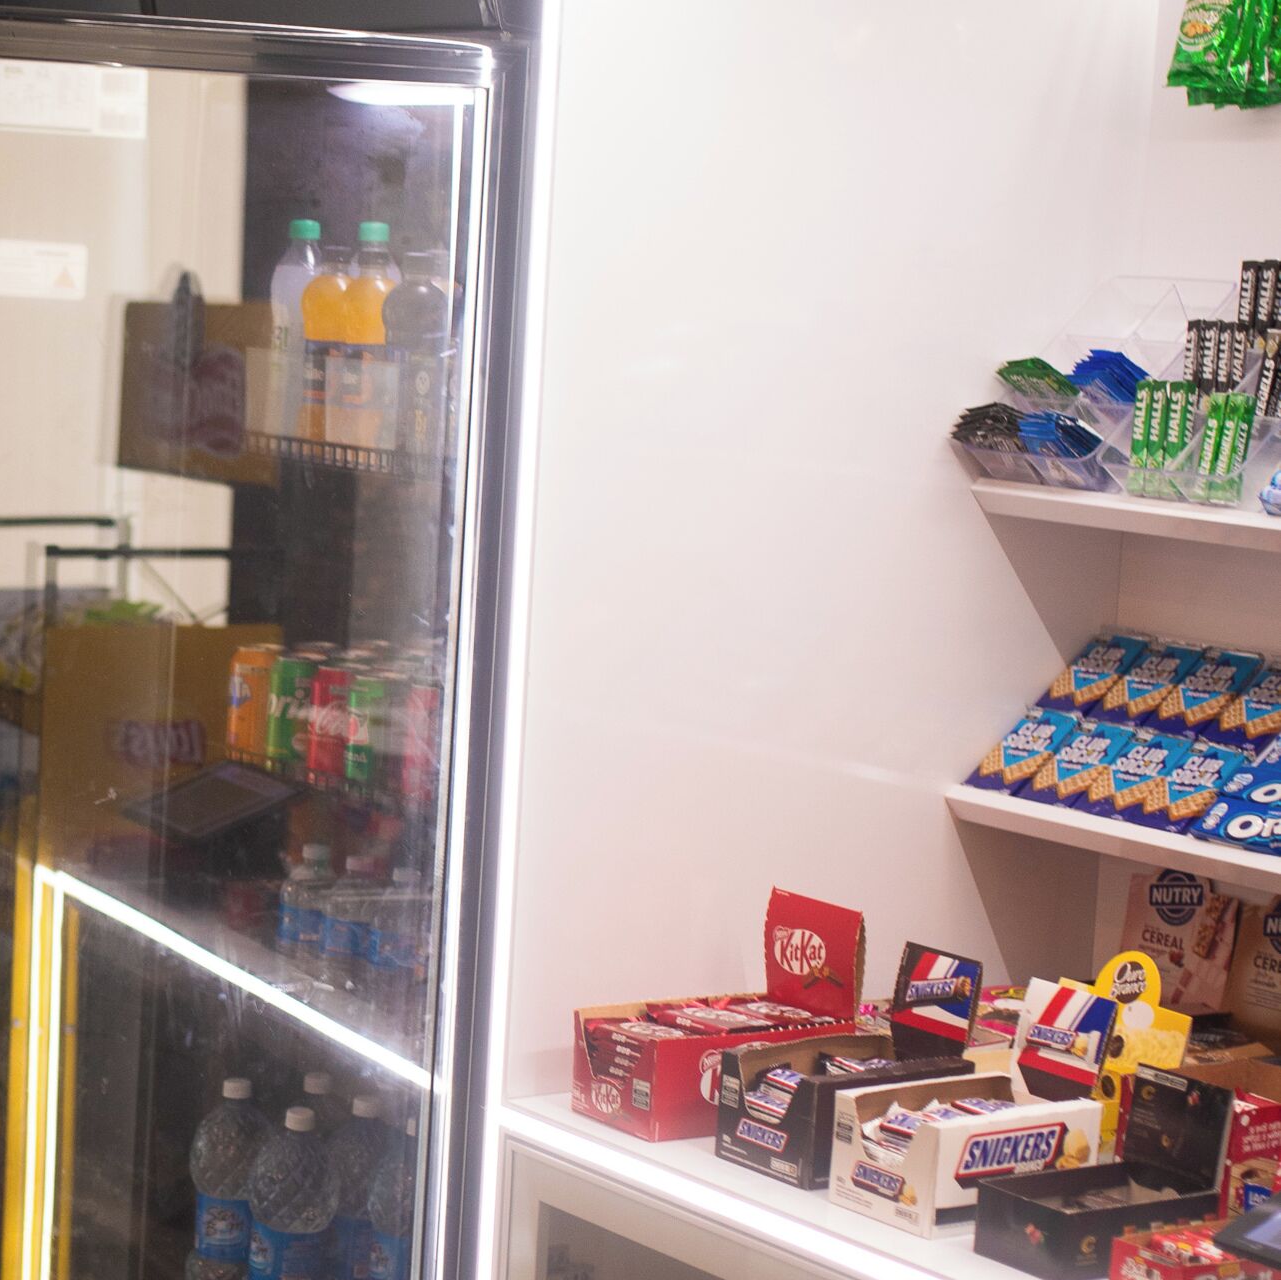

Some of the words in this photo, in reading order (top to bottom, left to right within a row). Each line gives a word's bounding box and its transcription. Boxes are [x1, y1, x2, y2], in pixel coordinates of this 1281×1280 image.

[1240, 270, 1255, 321] HALLS
[1258, 269, 1276, 321] HALLS
[1184, 329, 1197, 381] HALLS
[1203, 329, 1217, 381] HALLS
[1217, 330, 1231, 382] HALLS
[1232, 330, 1246, 382] HALLS
[1133, 388, 1148, 441] HALLS
[1149, 389, 1164, 442] HALLS
[1167, 390, 1184, 443] HALLS
[1150, 884, 1202, 907] NUTRY
[779, 930, 825, 973] KitKat
[1141, 928, 1185, 951] CEREAL
[964, 1129, 1057, 1171] SNICKERS
